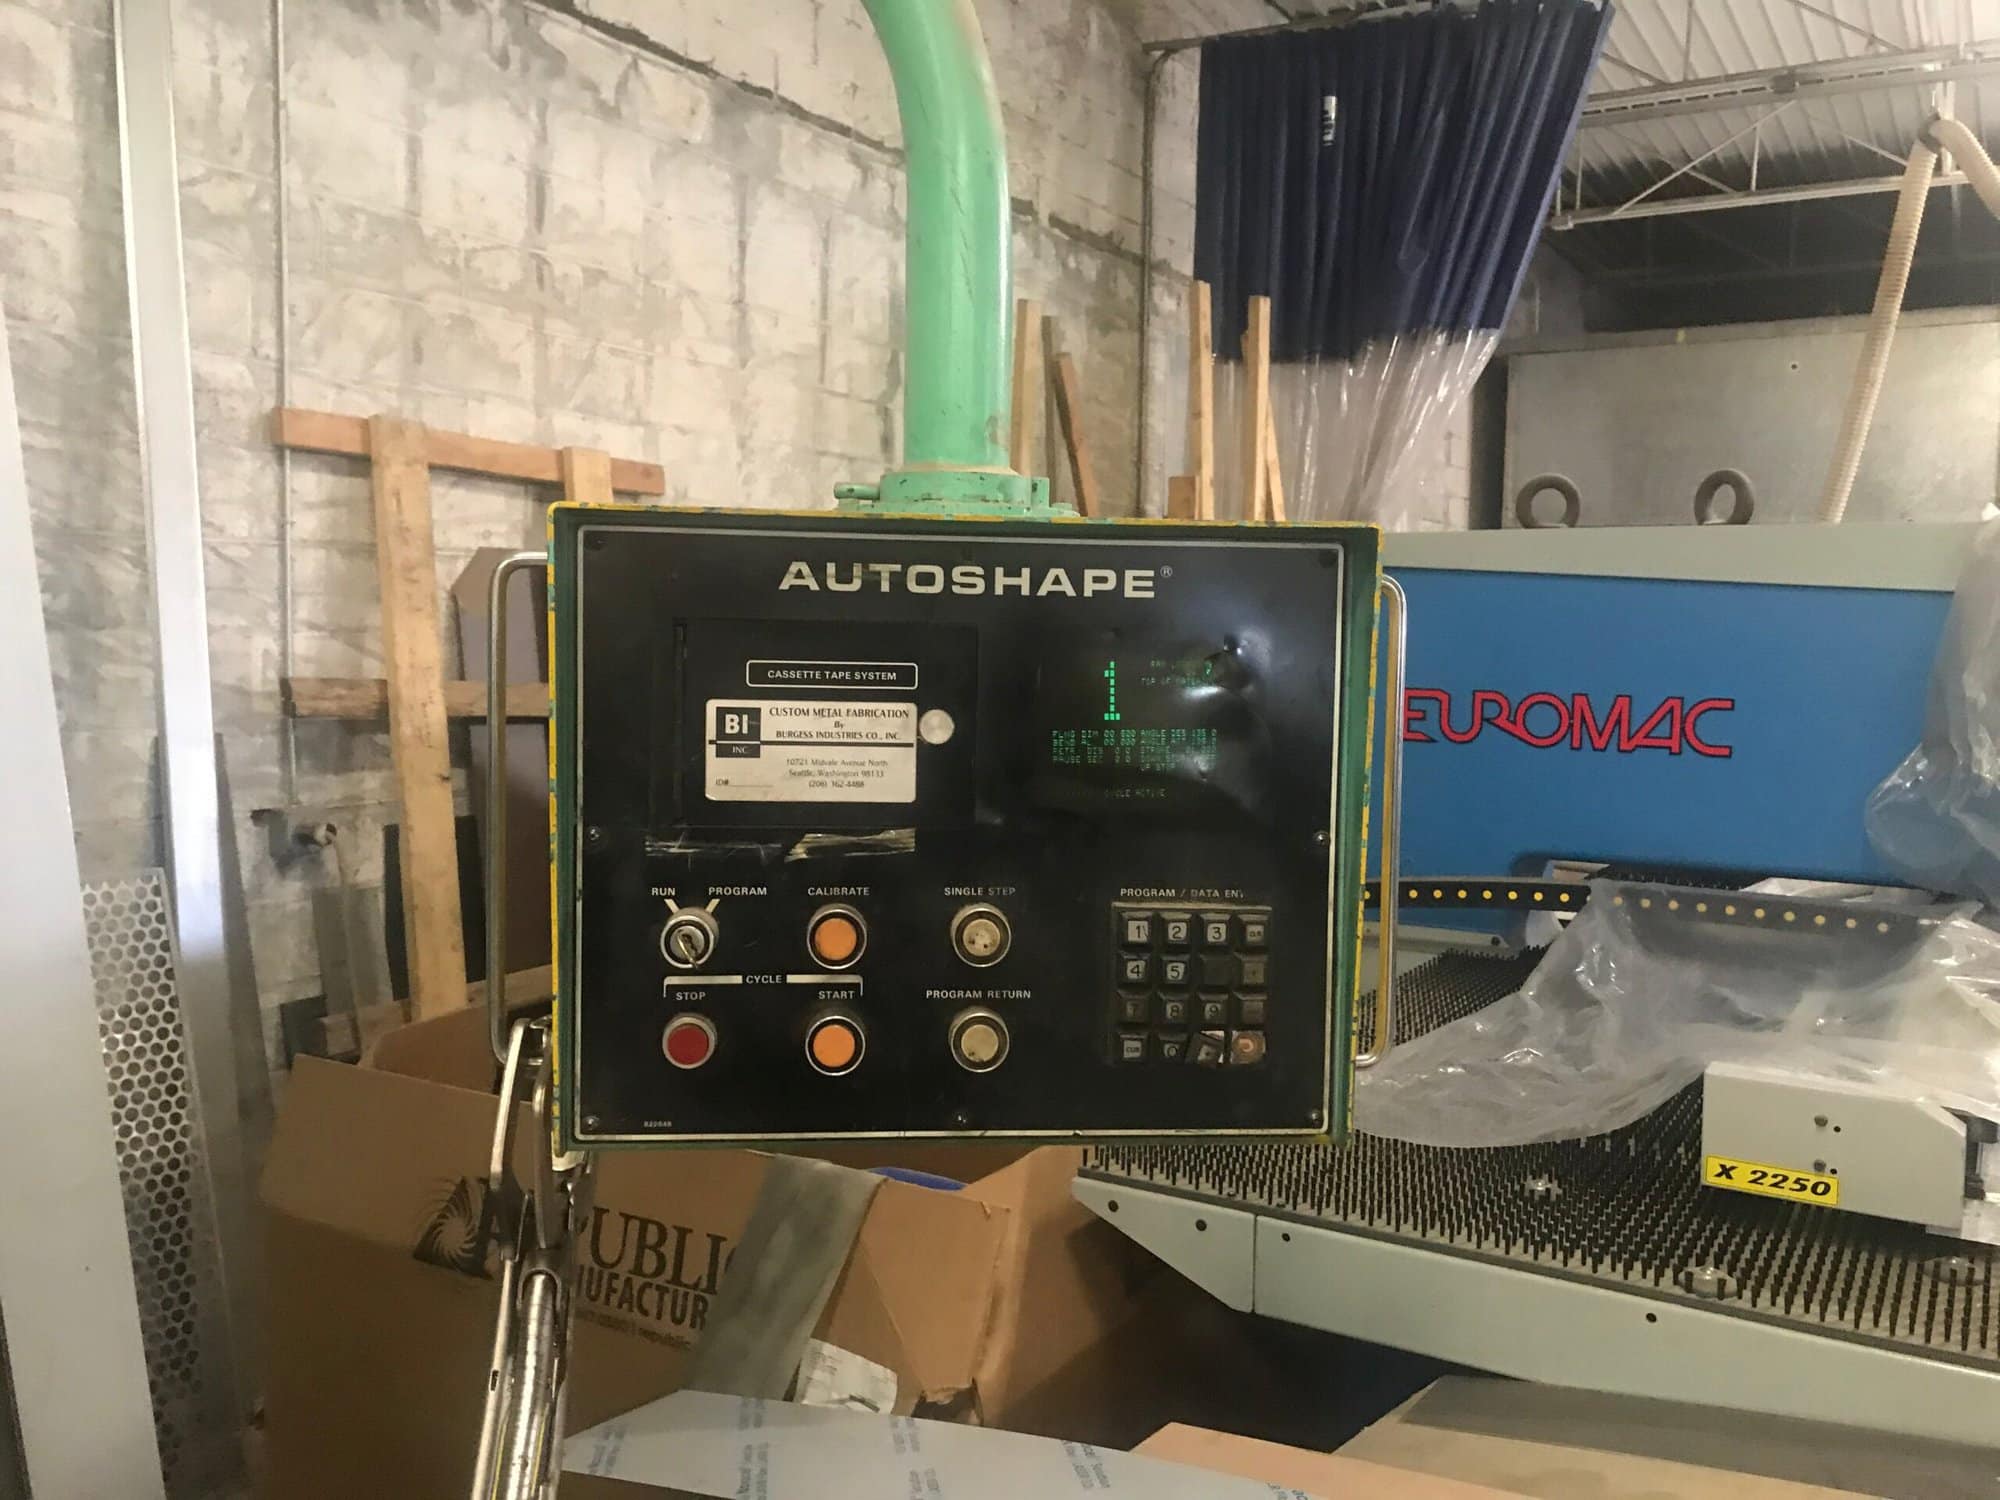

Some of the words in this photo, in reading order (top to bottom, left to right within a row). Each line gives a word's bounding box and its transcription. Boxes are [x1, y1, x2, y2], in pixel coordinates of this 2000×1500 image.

[767, 669, 822, 681] CASSETTE
[825, 670, 852, 681] TAPE
[854, 670, 897, 682] SYSTEM
[768, 707, 810, 718] CUSTOM
[812, 708, 843, 718] METAL
[846, 708, 909, 719] FABRICATION
[724, 713, 749, 735] BI
[833, 720, 846, 730] By
[1402, 688, 1735, 758] EUROMAC
[775, 730, 814, 739] BURGESS
[816, 731, 863, 740] INDUSTRIES
[840, 759, 866, 768] Avenue
[868, 759, 888, 768] North
[650, 886, 677, 897] RUN
[708, 886, 768, 897] PROGRAM
[807, 886, 871, 897] CALIBRATE
[943, 886, 985, 897] SINGLE
[987, 886, 1016, 897] STEP
[1119, 888, 1176, 898] PROGRAM
[1190, 889, 1220, 898] DATA
[1135, 925, 1142, 938] 1
[1171, 925, 1182, 940] 2
[1212, 926, 1222, 940] 3
[1130, 964, 1141, 977] 4
[1170, 965, 1180, 979] 5
[745, 974, 783, 984] CYCLE
[675, 990, 706, 1001] STOP
[818, 989, 855, 1000] START
[925, 989, 983, 1000] PROGRAM
[986, 989, 1032, 1000] RETURN
[1713, 1163, 1739, 1180] X
[1747, 1169, 1832, 1196] 2250
[575, 1264, 710, 1331] UFACTUR
